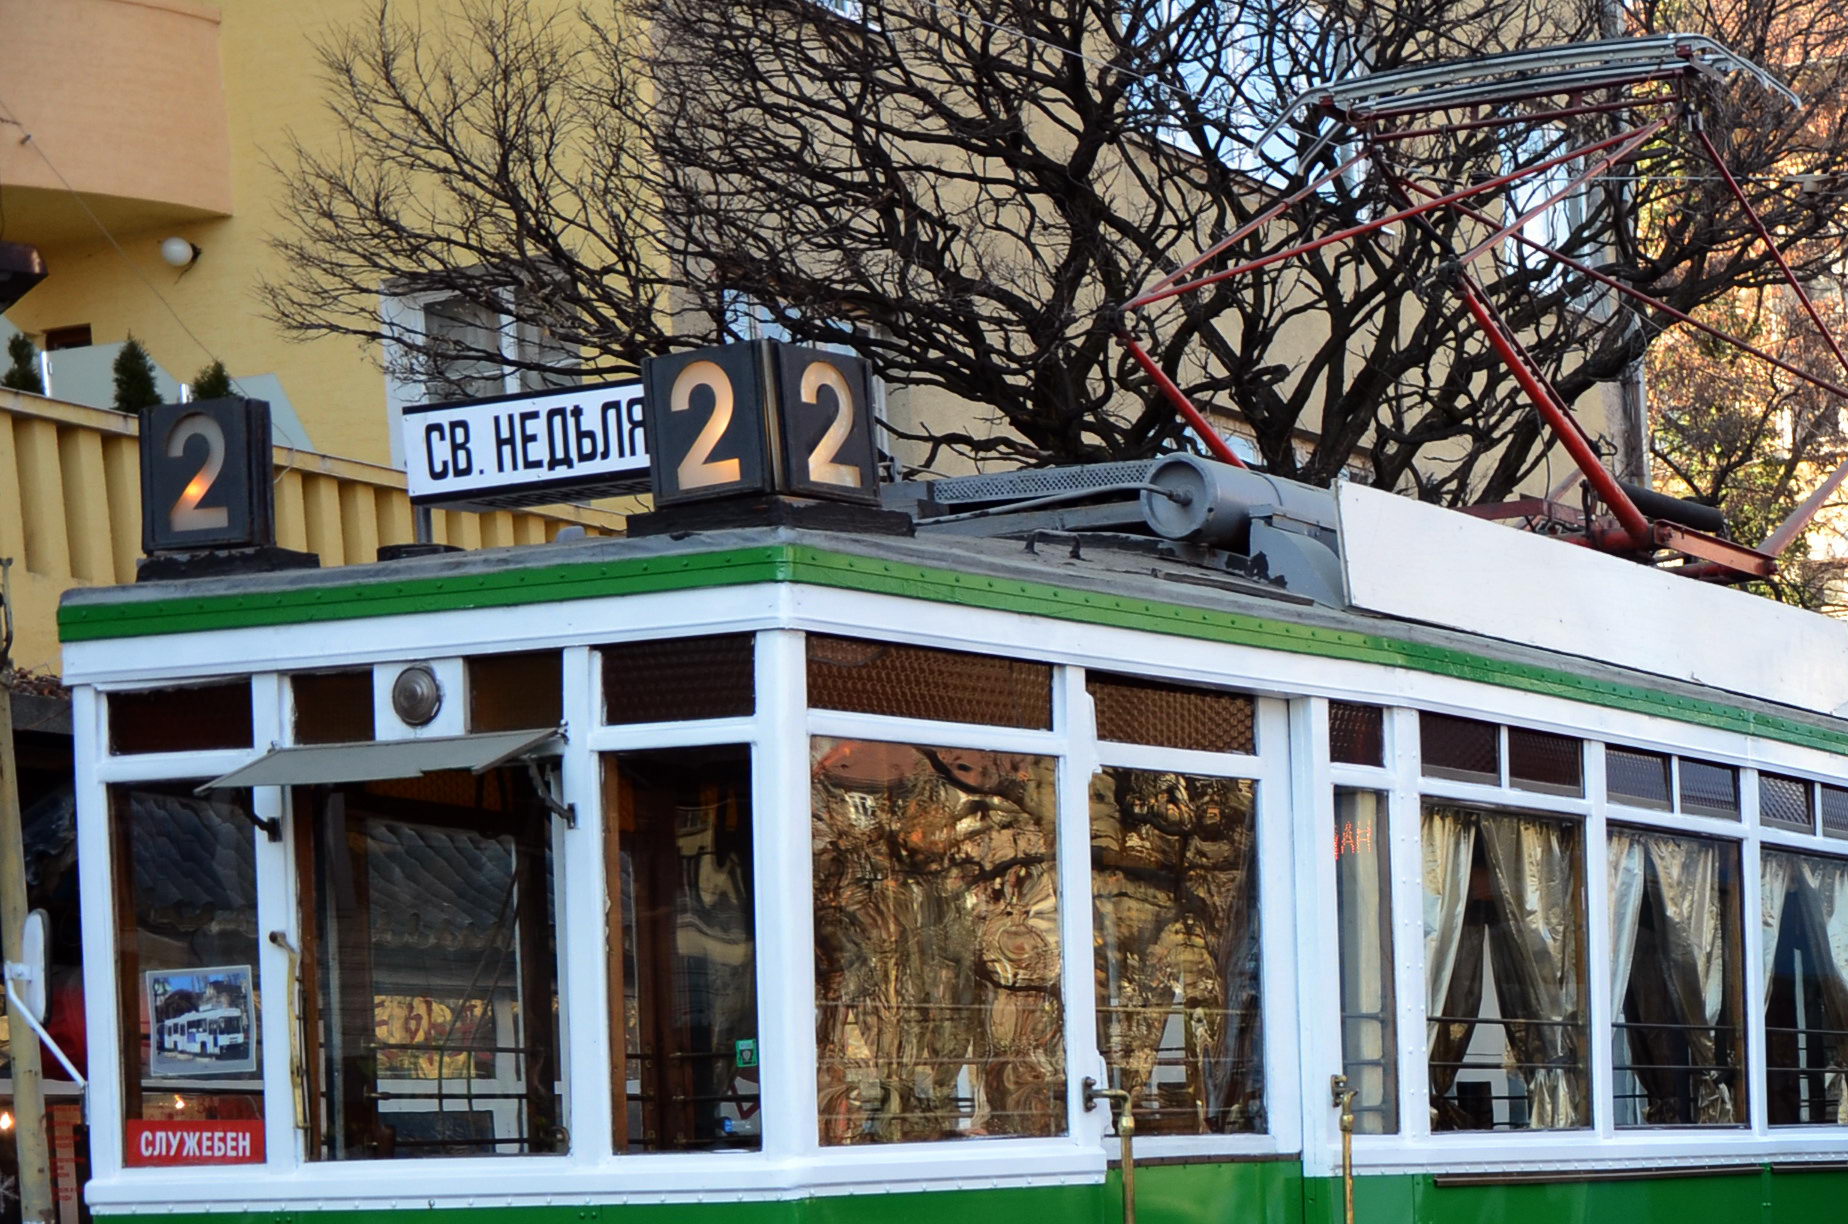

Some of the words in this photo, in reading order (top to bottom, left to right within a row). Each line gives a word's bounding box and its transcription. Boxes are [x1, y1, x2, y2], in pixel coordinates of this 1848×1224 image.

[168, 413, 229, 532] 2
[425, 419, 484, 481] СВ.
[671, 360, 741, 490] 2
[801, 361, 862, 488] 2
[140, 1130, 250, 1157] СЛУЖЕБЕН
